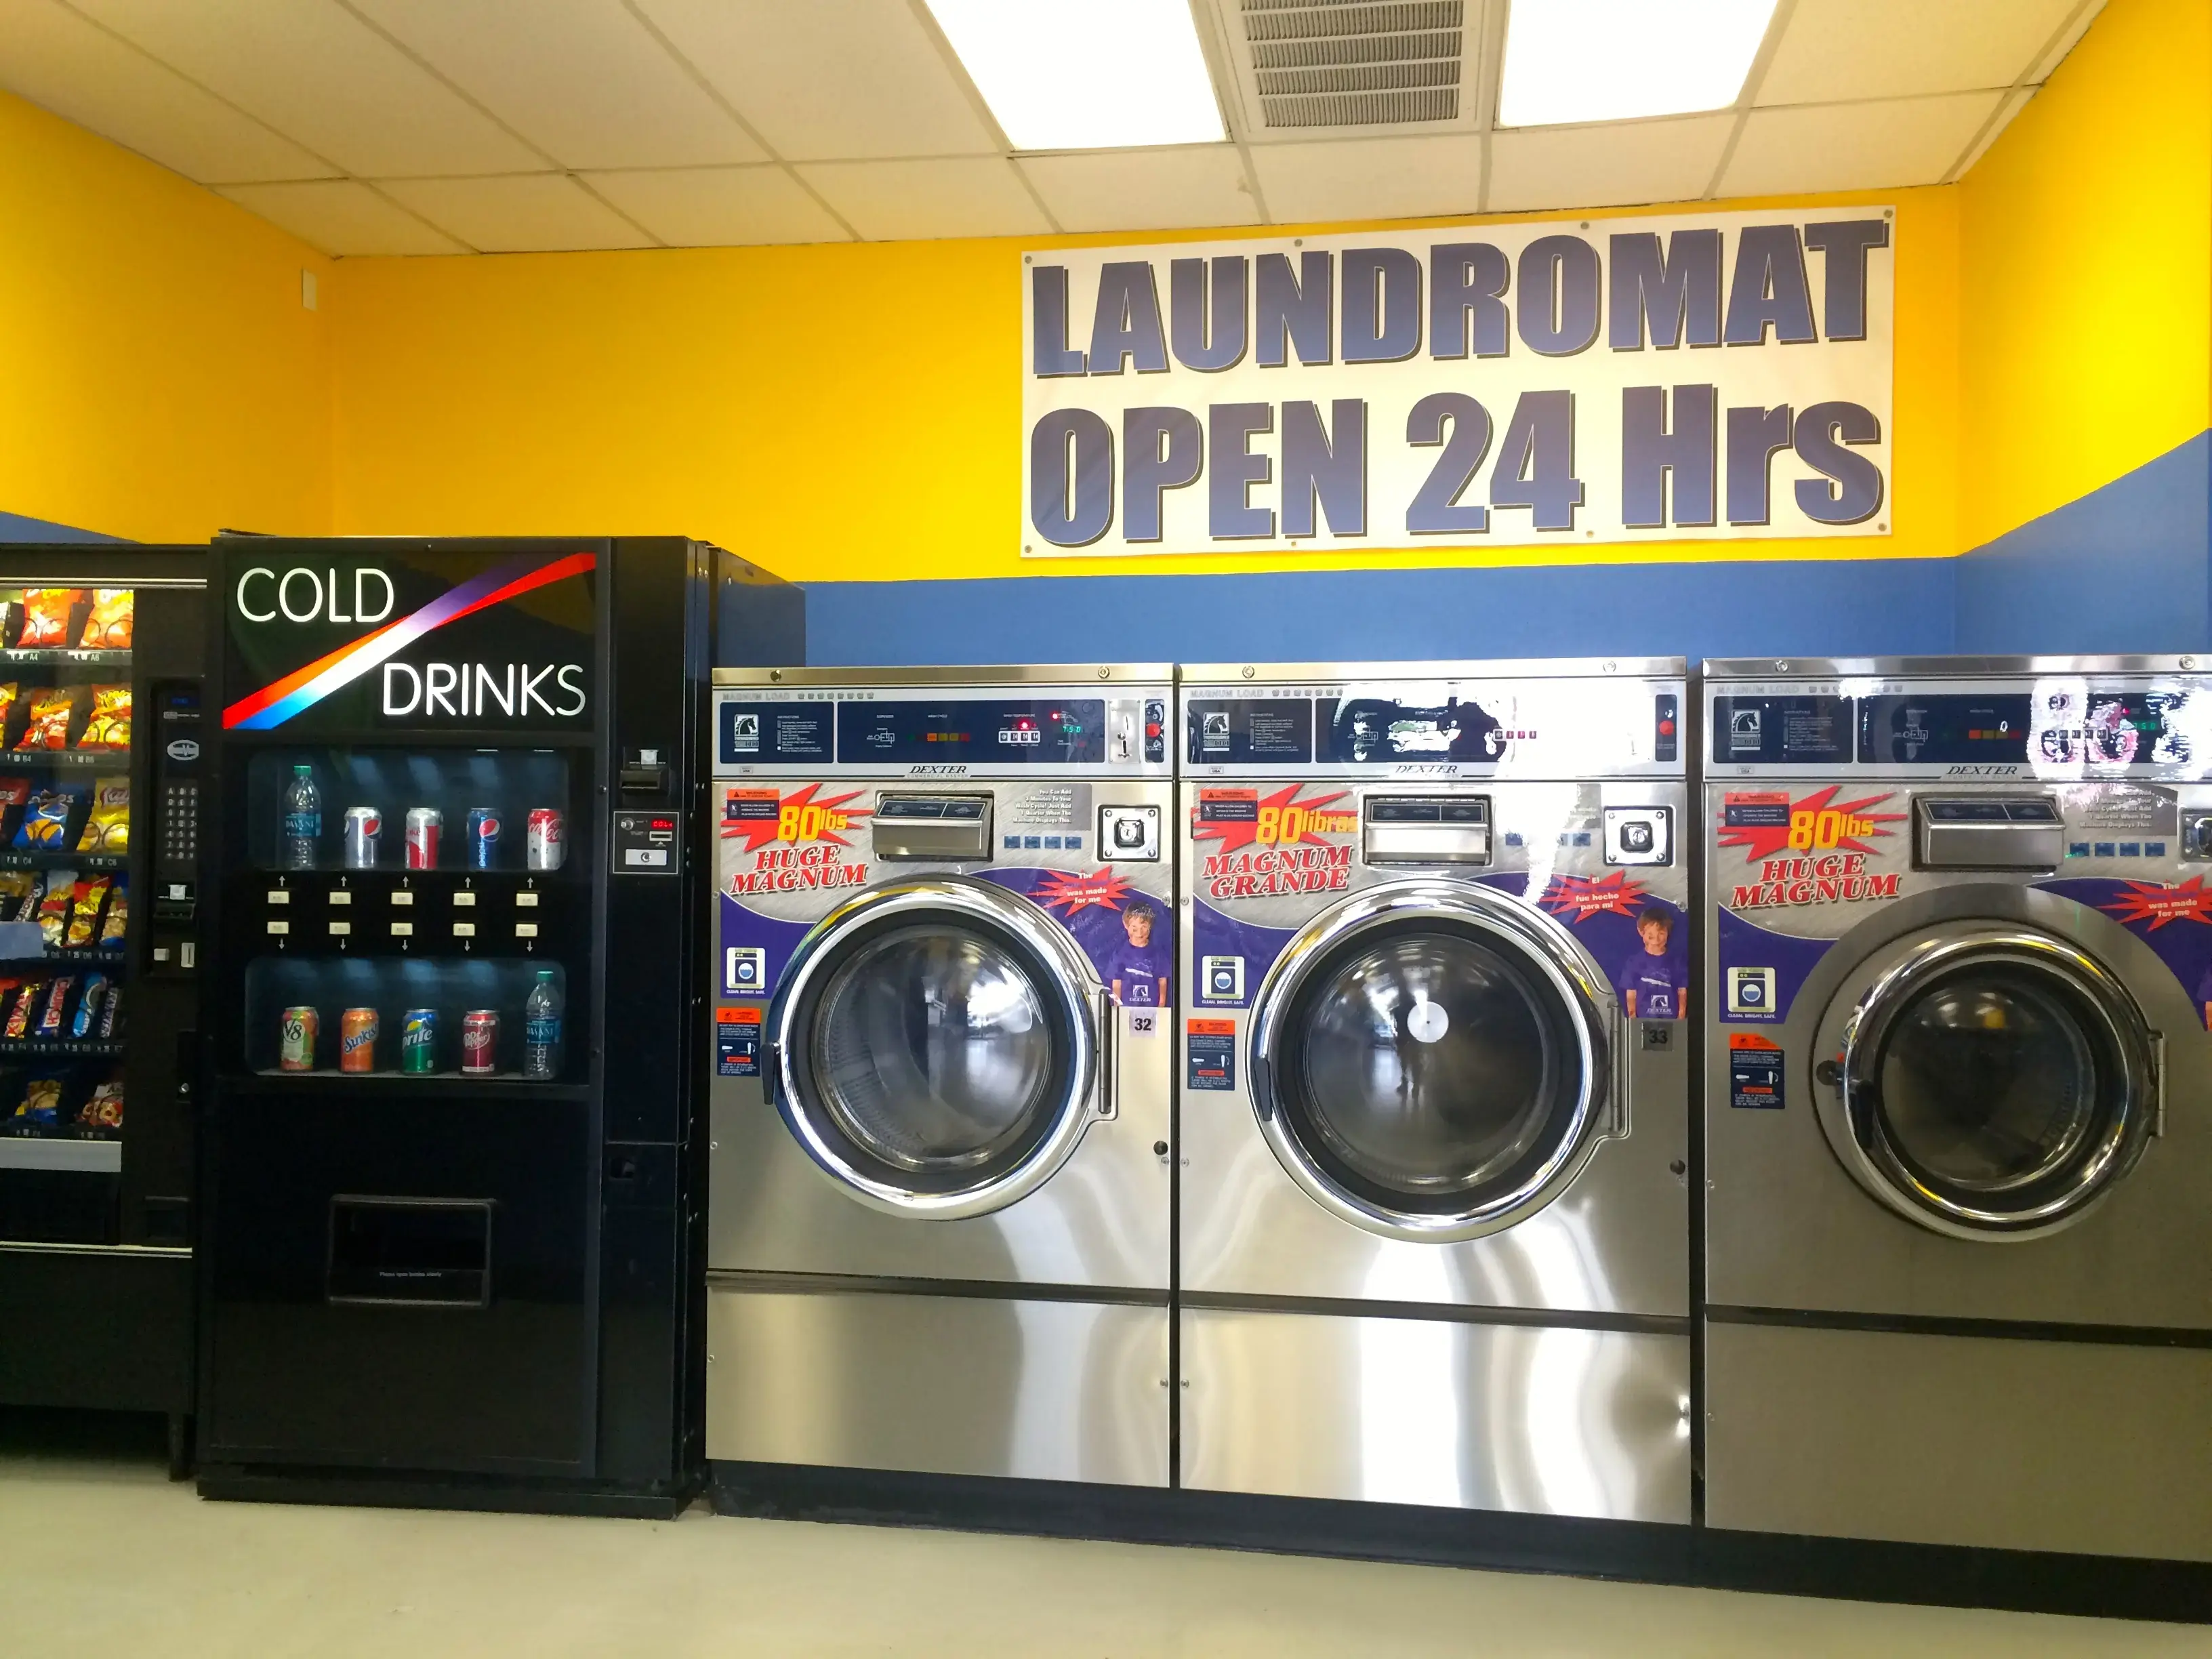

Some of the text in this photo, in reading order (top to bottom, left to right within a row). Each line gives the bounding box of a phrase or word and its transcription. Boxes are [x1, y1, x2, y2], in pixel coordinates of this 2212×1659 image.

[1032, 218, 1891, 378] LAUNDROMAT
[1030, 383, 1883, 548] OPEN 24 Hrs
[237, 567, 395, 623] COLD
[382, 662, 587, 716] DRINKS
[722, 692, 791, 701] MAGNUM LOAD
[1190, 689, 1265, 698] MAGNUM LOAD
[1716, 685, 1800, 694] MAGNUM LOAD
[909, 765, 967, 774] DEXTER
[1395, 765, 1458, 774] DEXTER
[1946, 766, 2018, 775] DEXTER
[754, 844, 841, 873] HUGE
[1202, 844, 1353, 878] MAGNUM
[1759, 852, 1868, 885] HUGE
[729, 863, 869, 897] MAGNUM
[1210, 866, 1351, 899] GRANDE
[1592, 892, 1620, 901] hecho
[1729, 873, 1903, 910] MAGNUM
[1580, 903, 1600, 912] para
[2171, 898, 2198, 907] made
[285, 1019, 302, 1040] V8
[1134, 1017, 1152, 1031] 32
[402, 1027, 433, 1050] prite
[1649, 1029, 1668, 1044] 33
